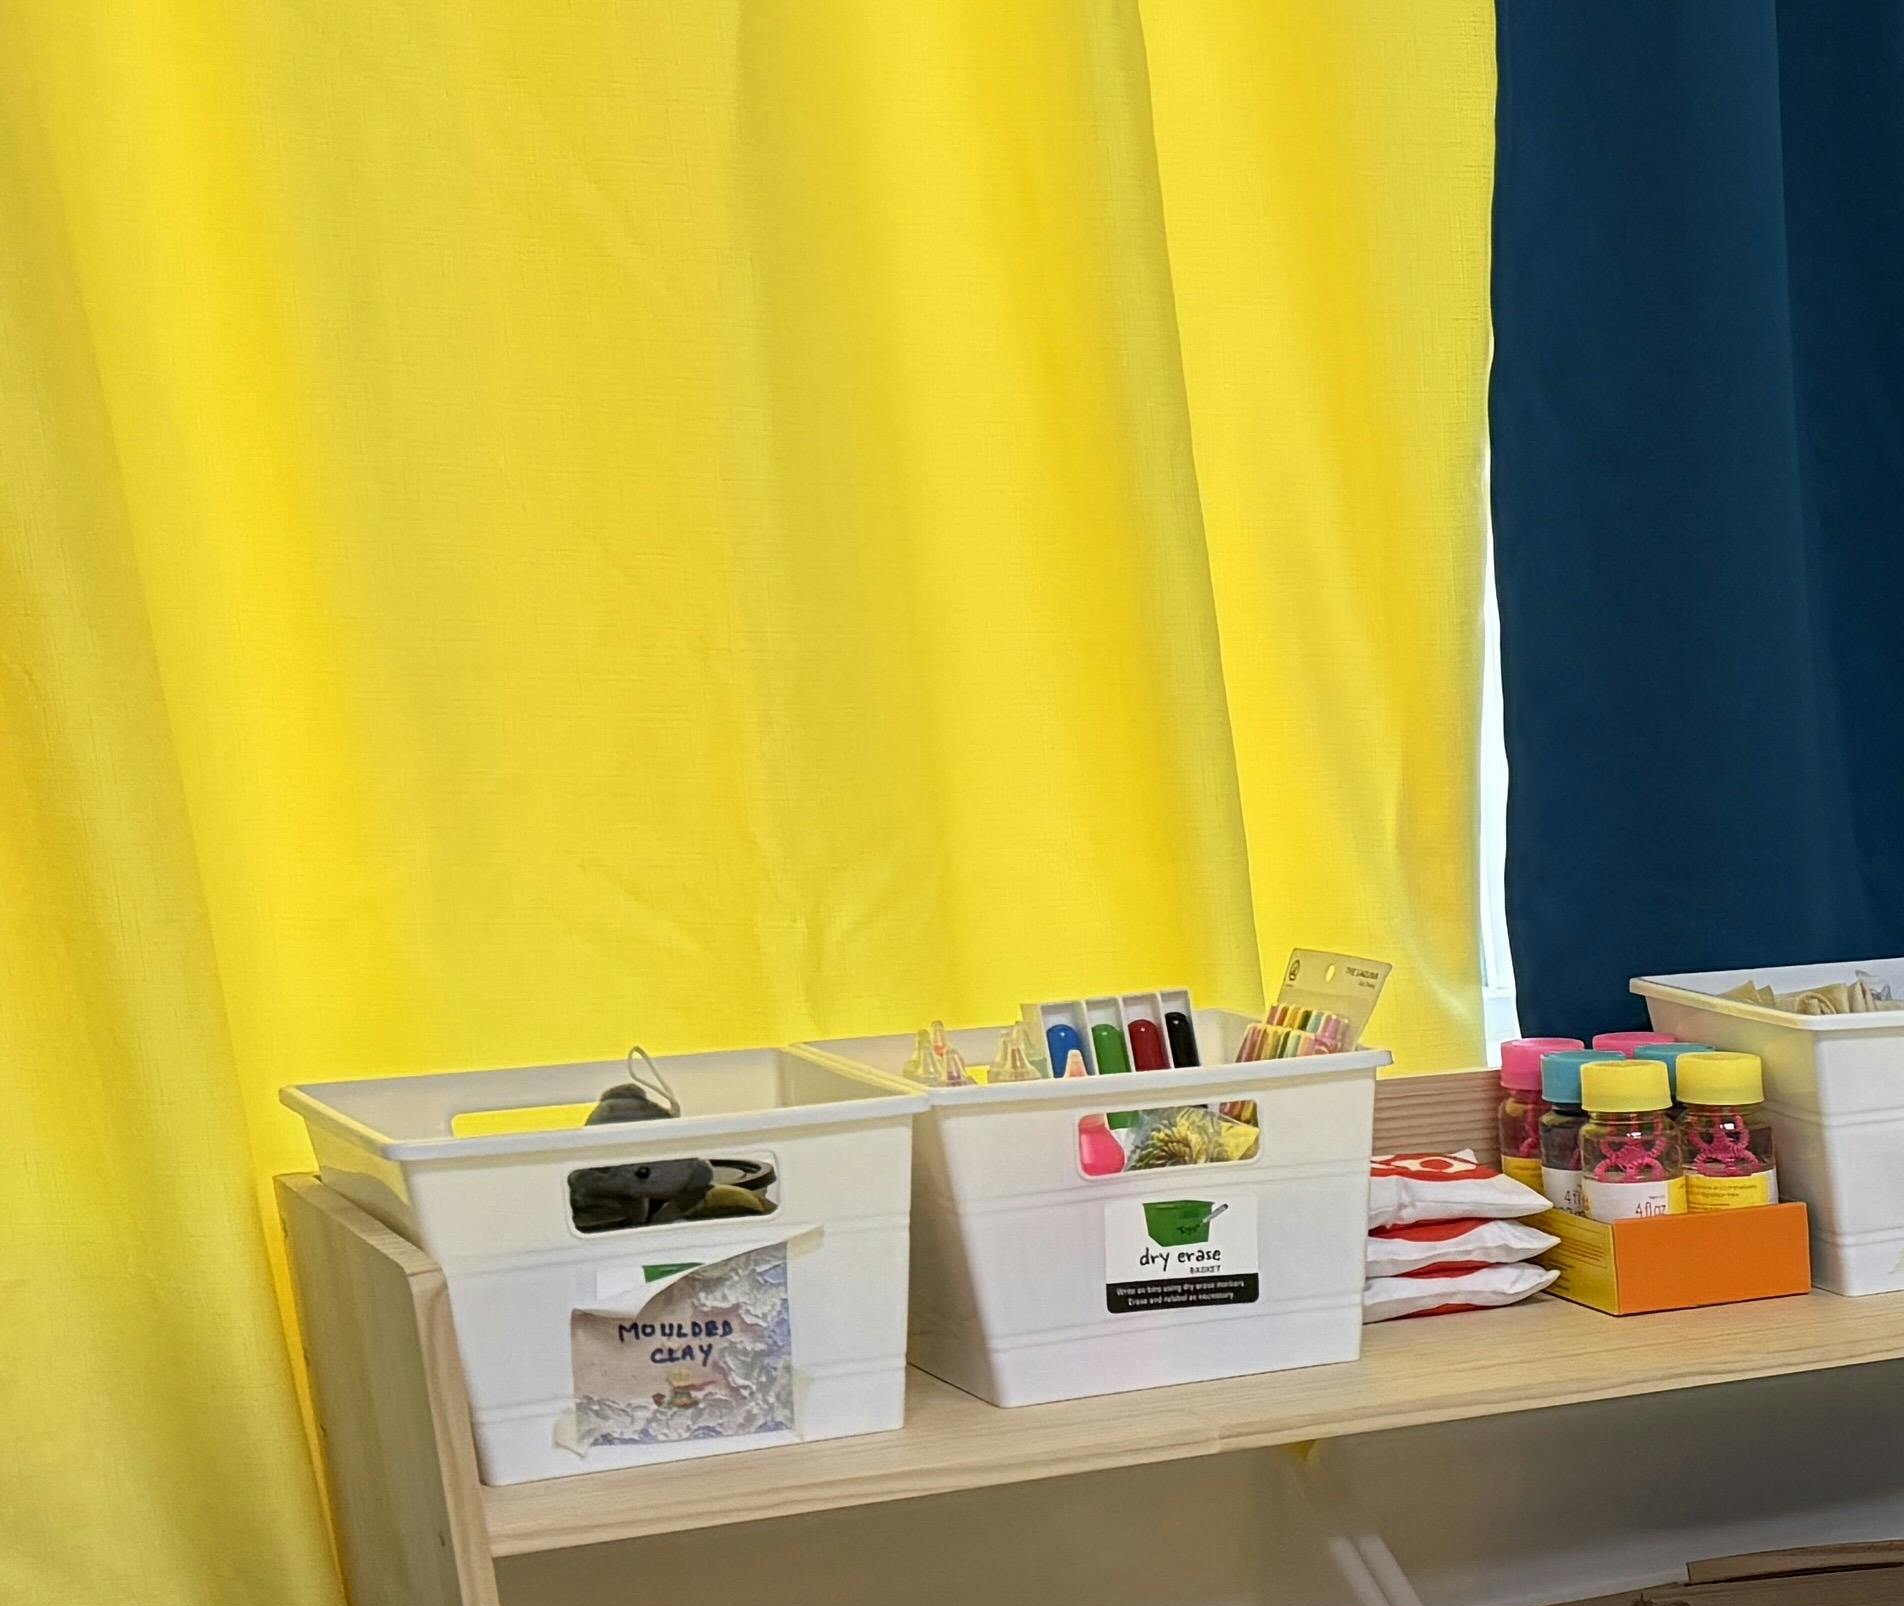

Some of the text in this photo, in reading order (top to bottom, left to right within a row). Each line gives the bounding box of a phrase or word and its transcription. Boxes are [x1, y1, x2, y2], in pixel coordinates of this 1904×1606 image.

[1139, 1247, 1222, 1272] dry erase
[618, 1320, 733, 1343] MOULDED
[650, 1343, 713, 1367] CLAY
